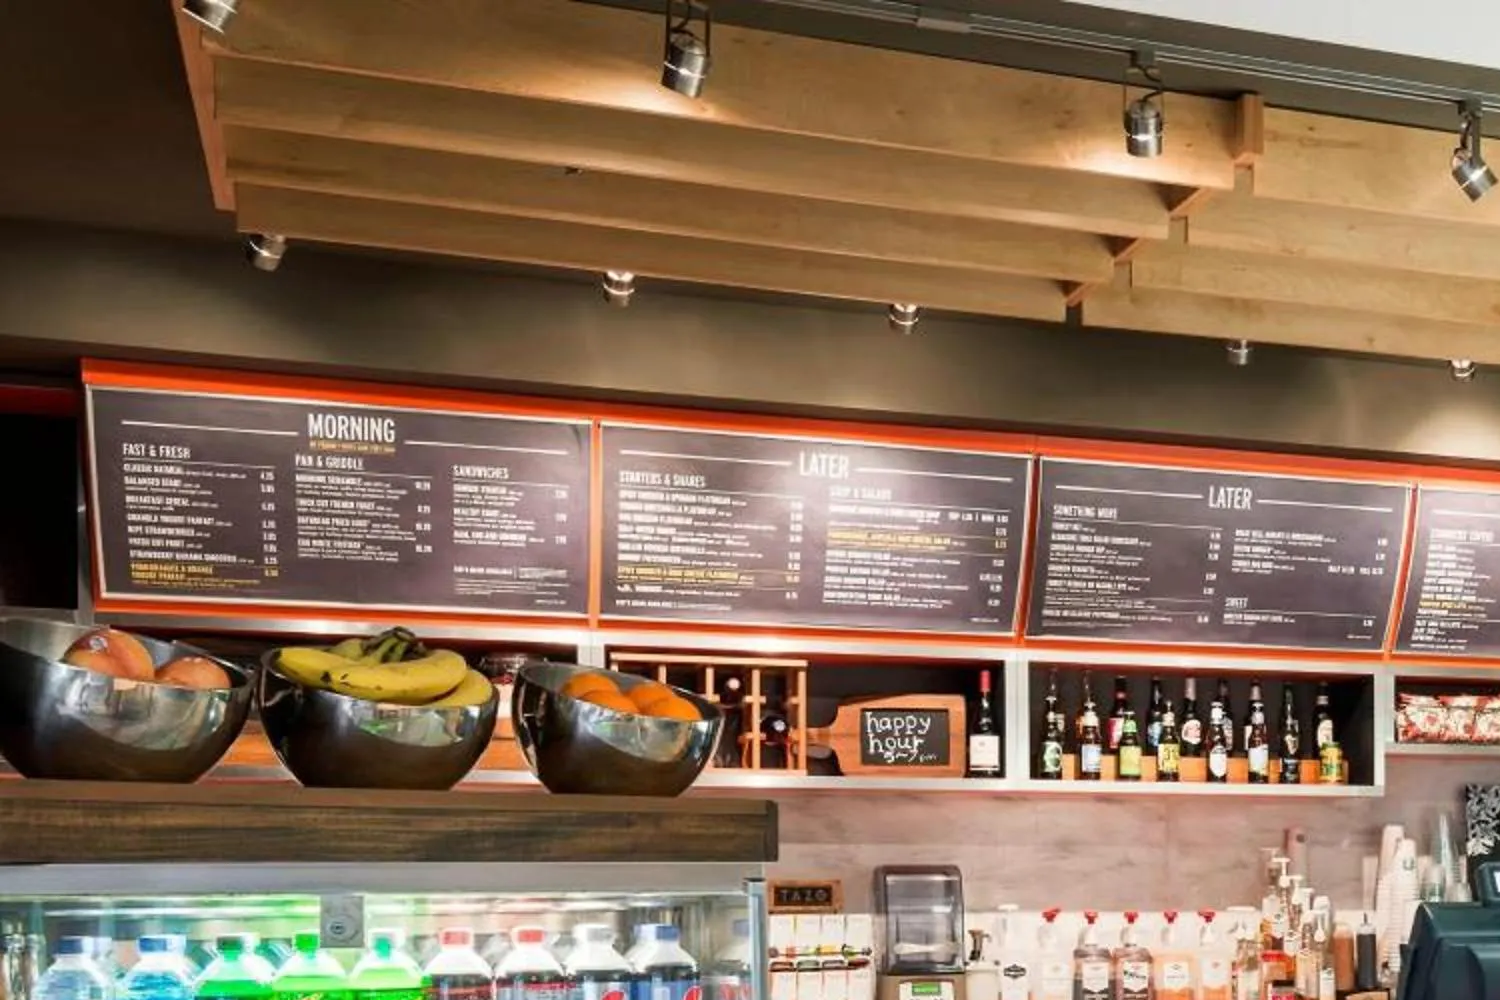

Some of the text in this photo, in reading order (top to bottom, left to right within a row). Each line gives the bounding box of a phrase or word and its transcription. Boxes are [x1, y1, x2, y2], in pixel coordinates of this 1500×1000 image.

[308, 413, 395, 443] MORNING
[123, 443, 145, 457] FAST
[159, 446, 191, 459] FRESH
[800, 451, 849, 478] LATER
[1208, 486, 1253, 510] LATER
[865, 711, 931, 737] happy
[868, 733, 924, 755] hour
[780, 889, 828, 903] TAZO
